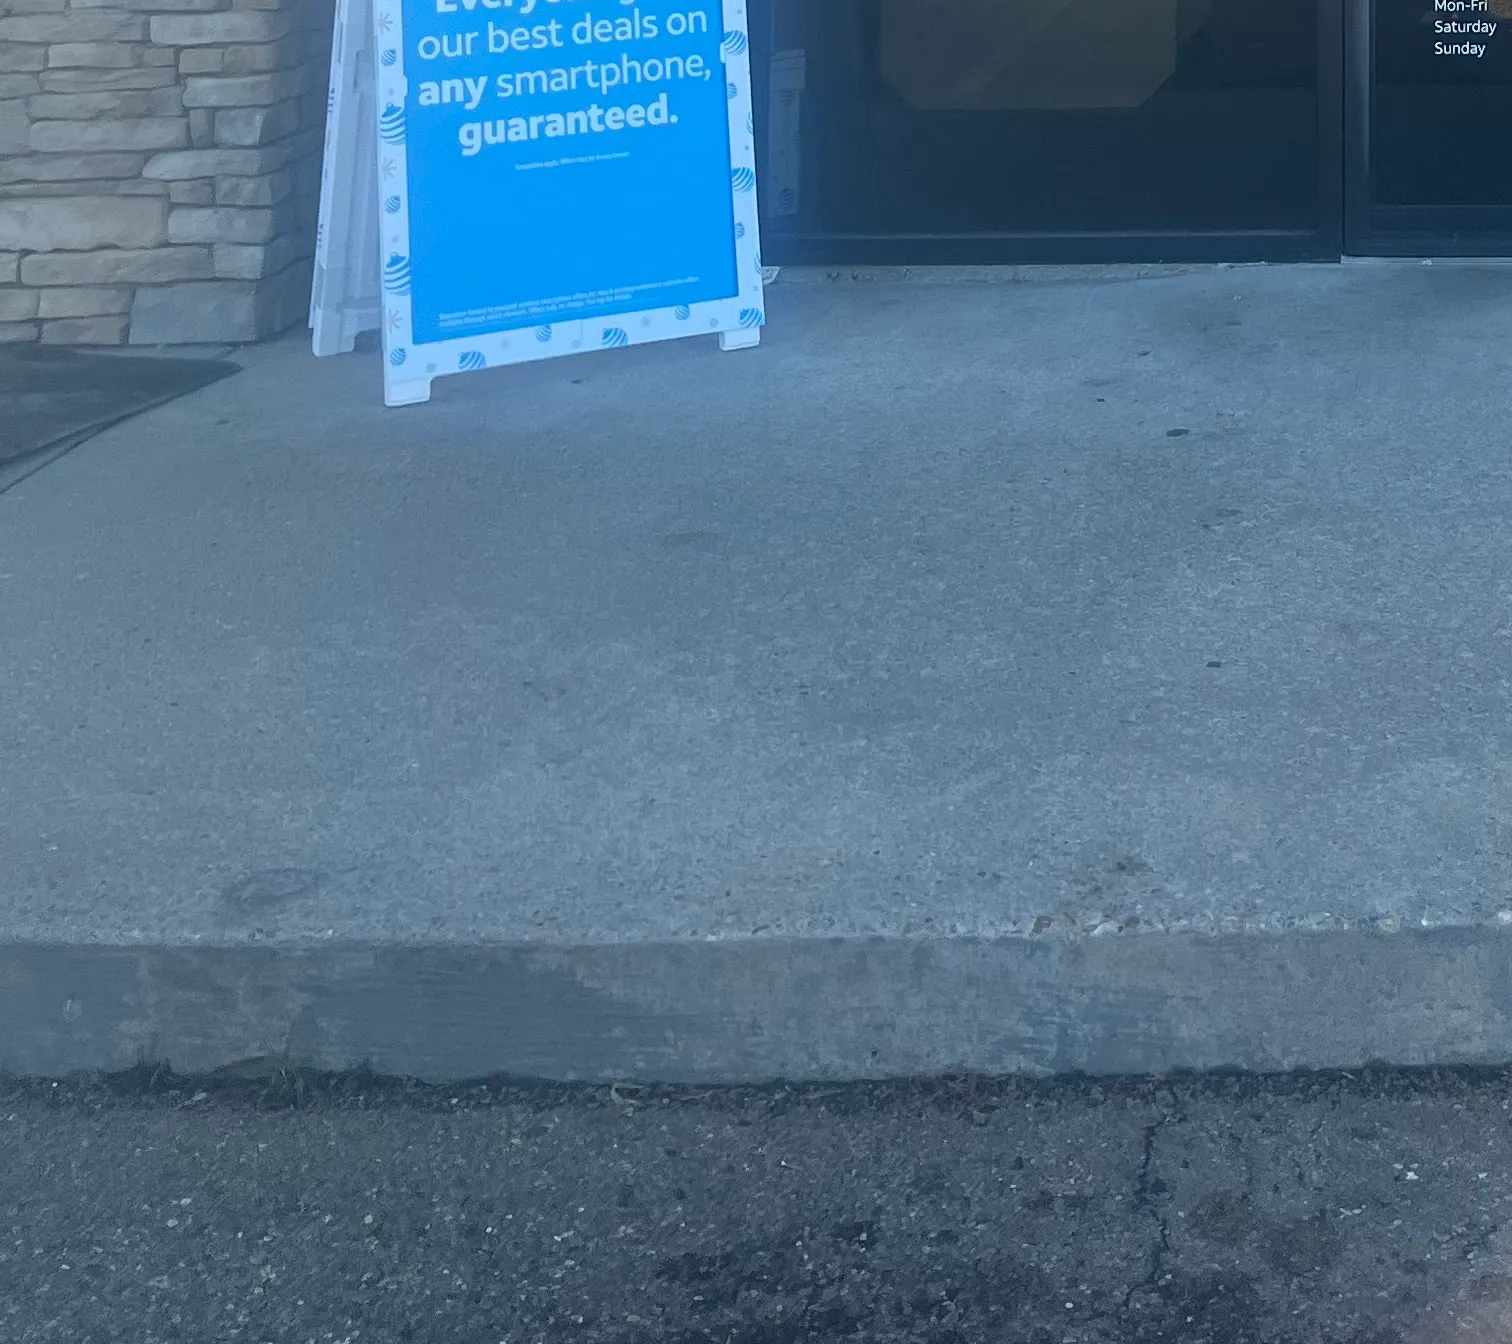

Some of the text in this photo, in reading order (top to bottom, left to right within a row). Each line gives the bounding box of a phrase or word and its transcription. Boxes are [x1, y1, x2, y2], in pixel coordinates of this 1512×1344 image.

[417, 7, 708, 60] our best deals on
[1434, 19, 1497, 37] Saturday
[1434, 41, 1487, 58] Sunday
[418, 53, 712, 109] any smartphone,
[458, 93, 679, 156] guaranteed.
